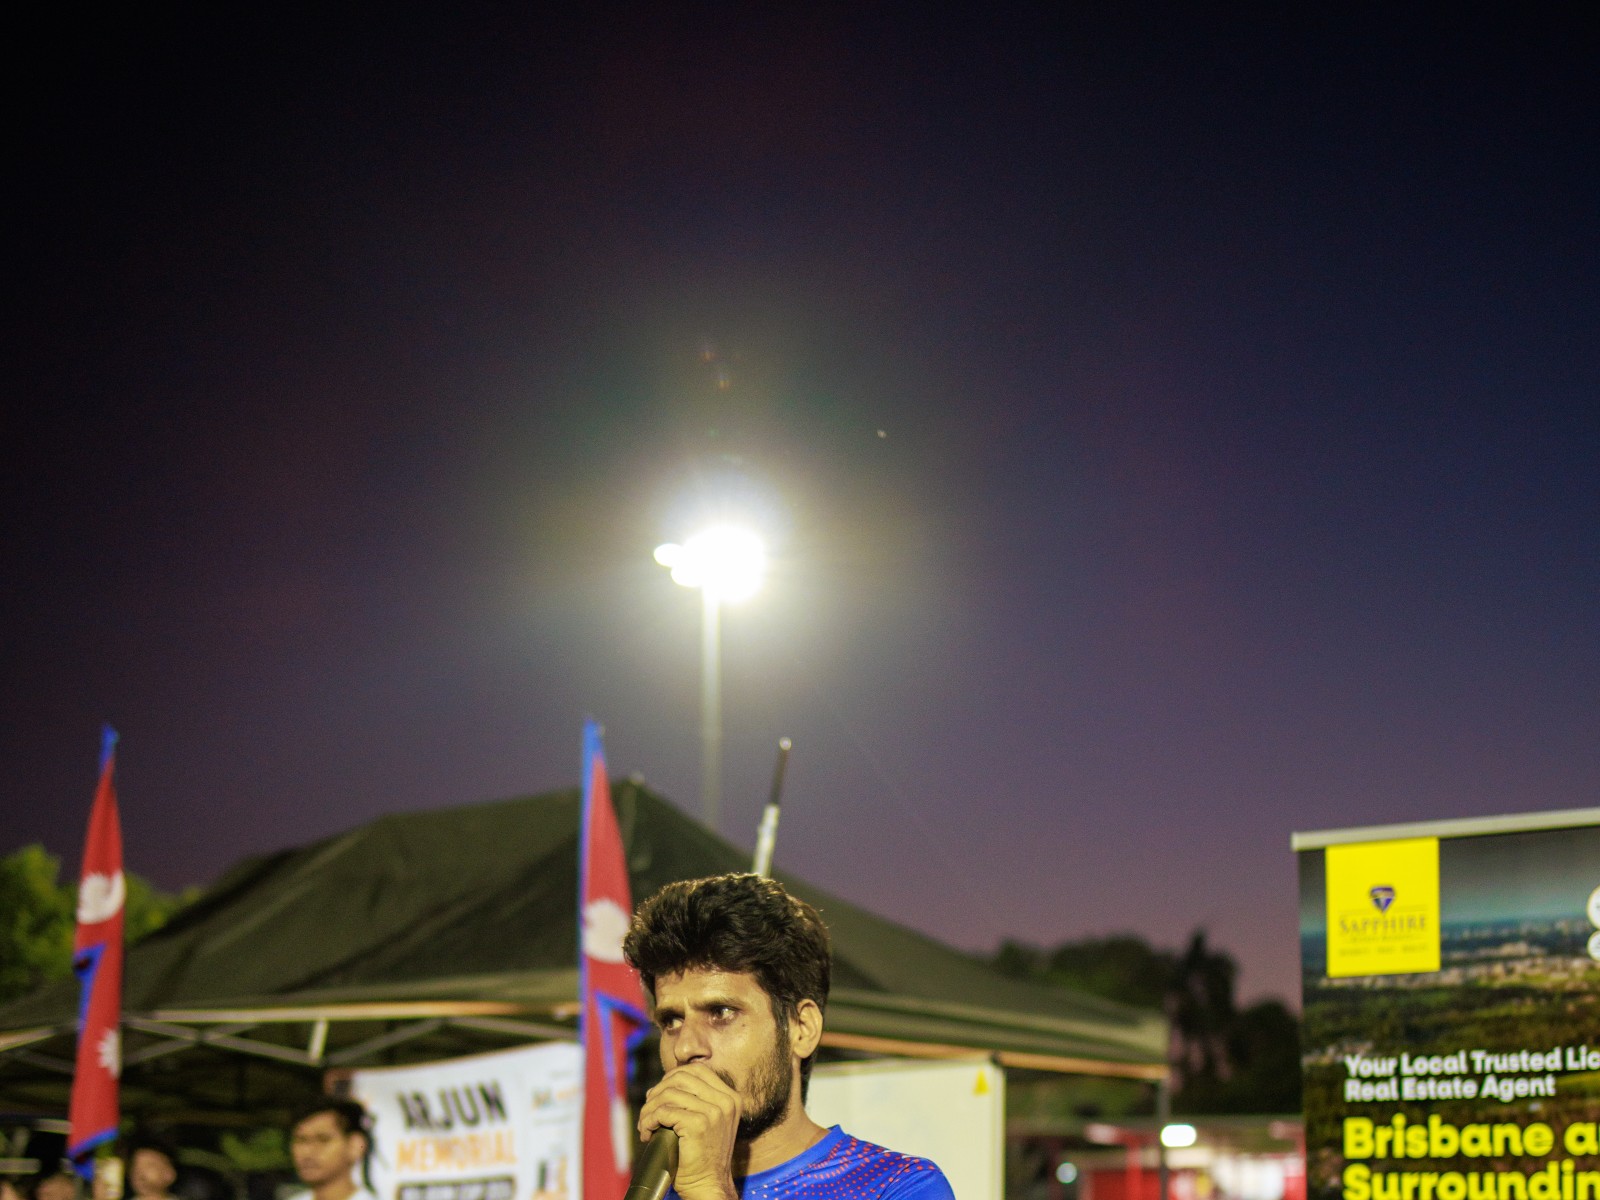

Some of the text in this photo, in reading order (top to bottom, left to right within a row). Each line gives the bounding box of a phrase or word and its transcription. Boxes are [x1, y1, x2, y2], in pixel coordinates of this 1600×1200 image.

[1344, 1053, 1398, 1078] Your
[1400, 1050, 1468, 1076] Local
[1470, 1046, 1563, 1073] Trusted
[1344, 1073, 1556, 1102] Real Estate Agent
[1343, 1112, 1555, 1159] Brisbane
